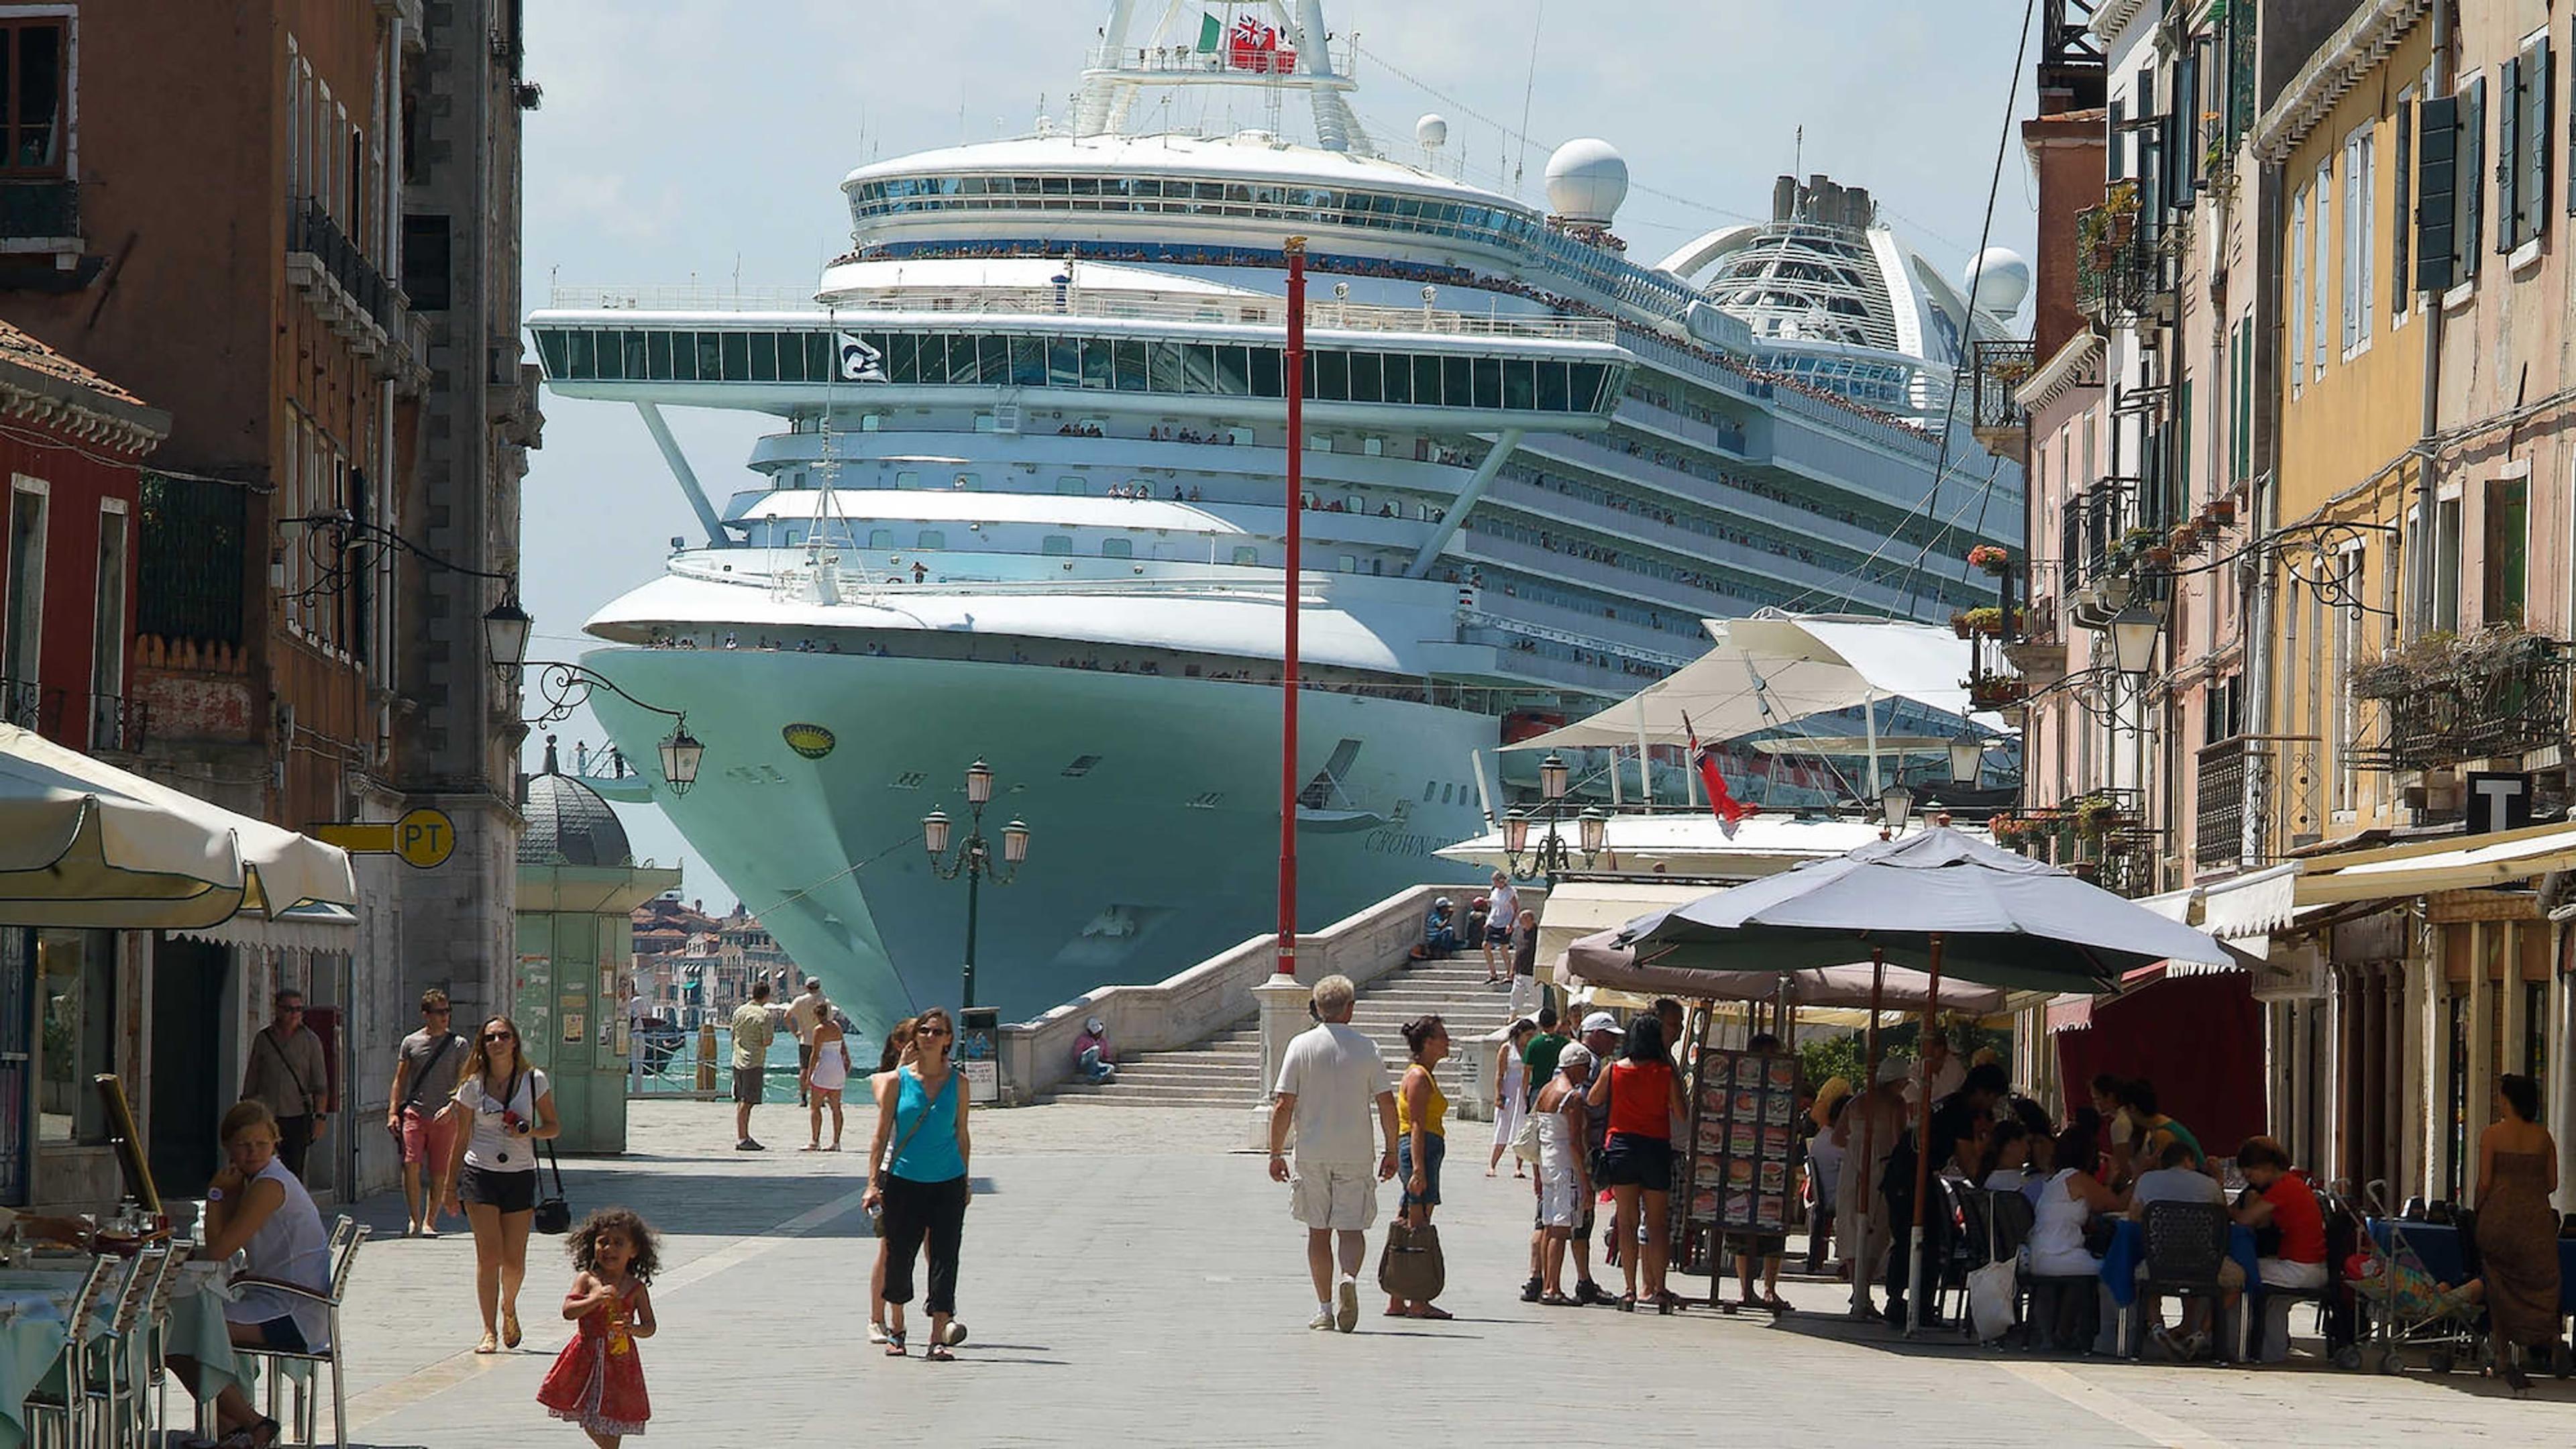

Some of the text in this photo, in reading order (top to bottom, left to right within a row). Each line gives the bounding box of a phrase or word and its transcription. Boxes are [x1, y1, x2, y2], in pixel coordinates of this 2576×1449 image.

[2476, 780, 2522, 833] T
[405, 824, 442, 852] PT
[1364, 829, 1430, 857] CROWN
